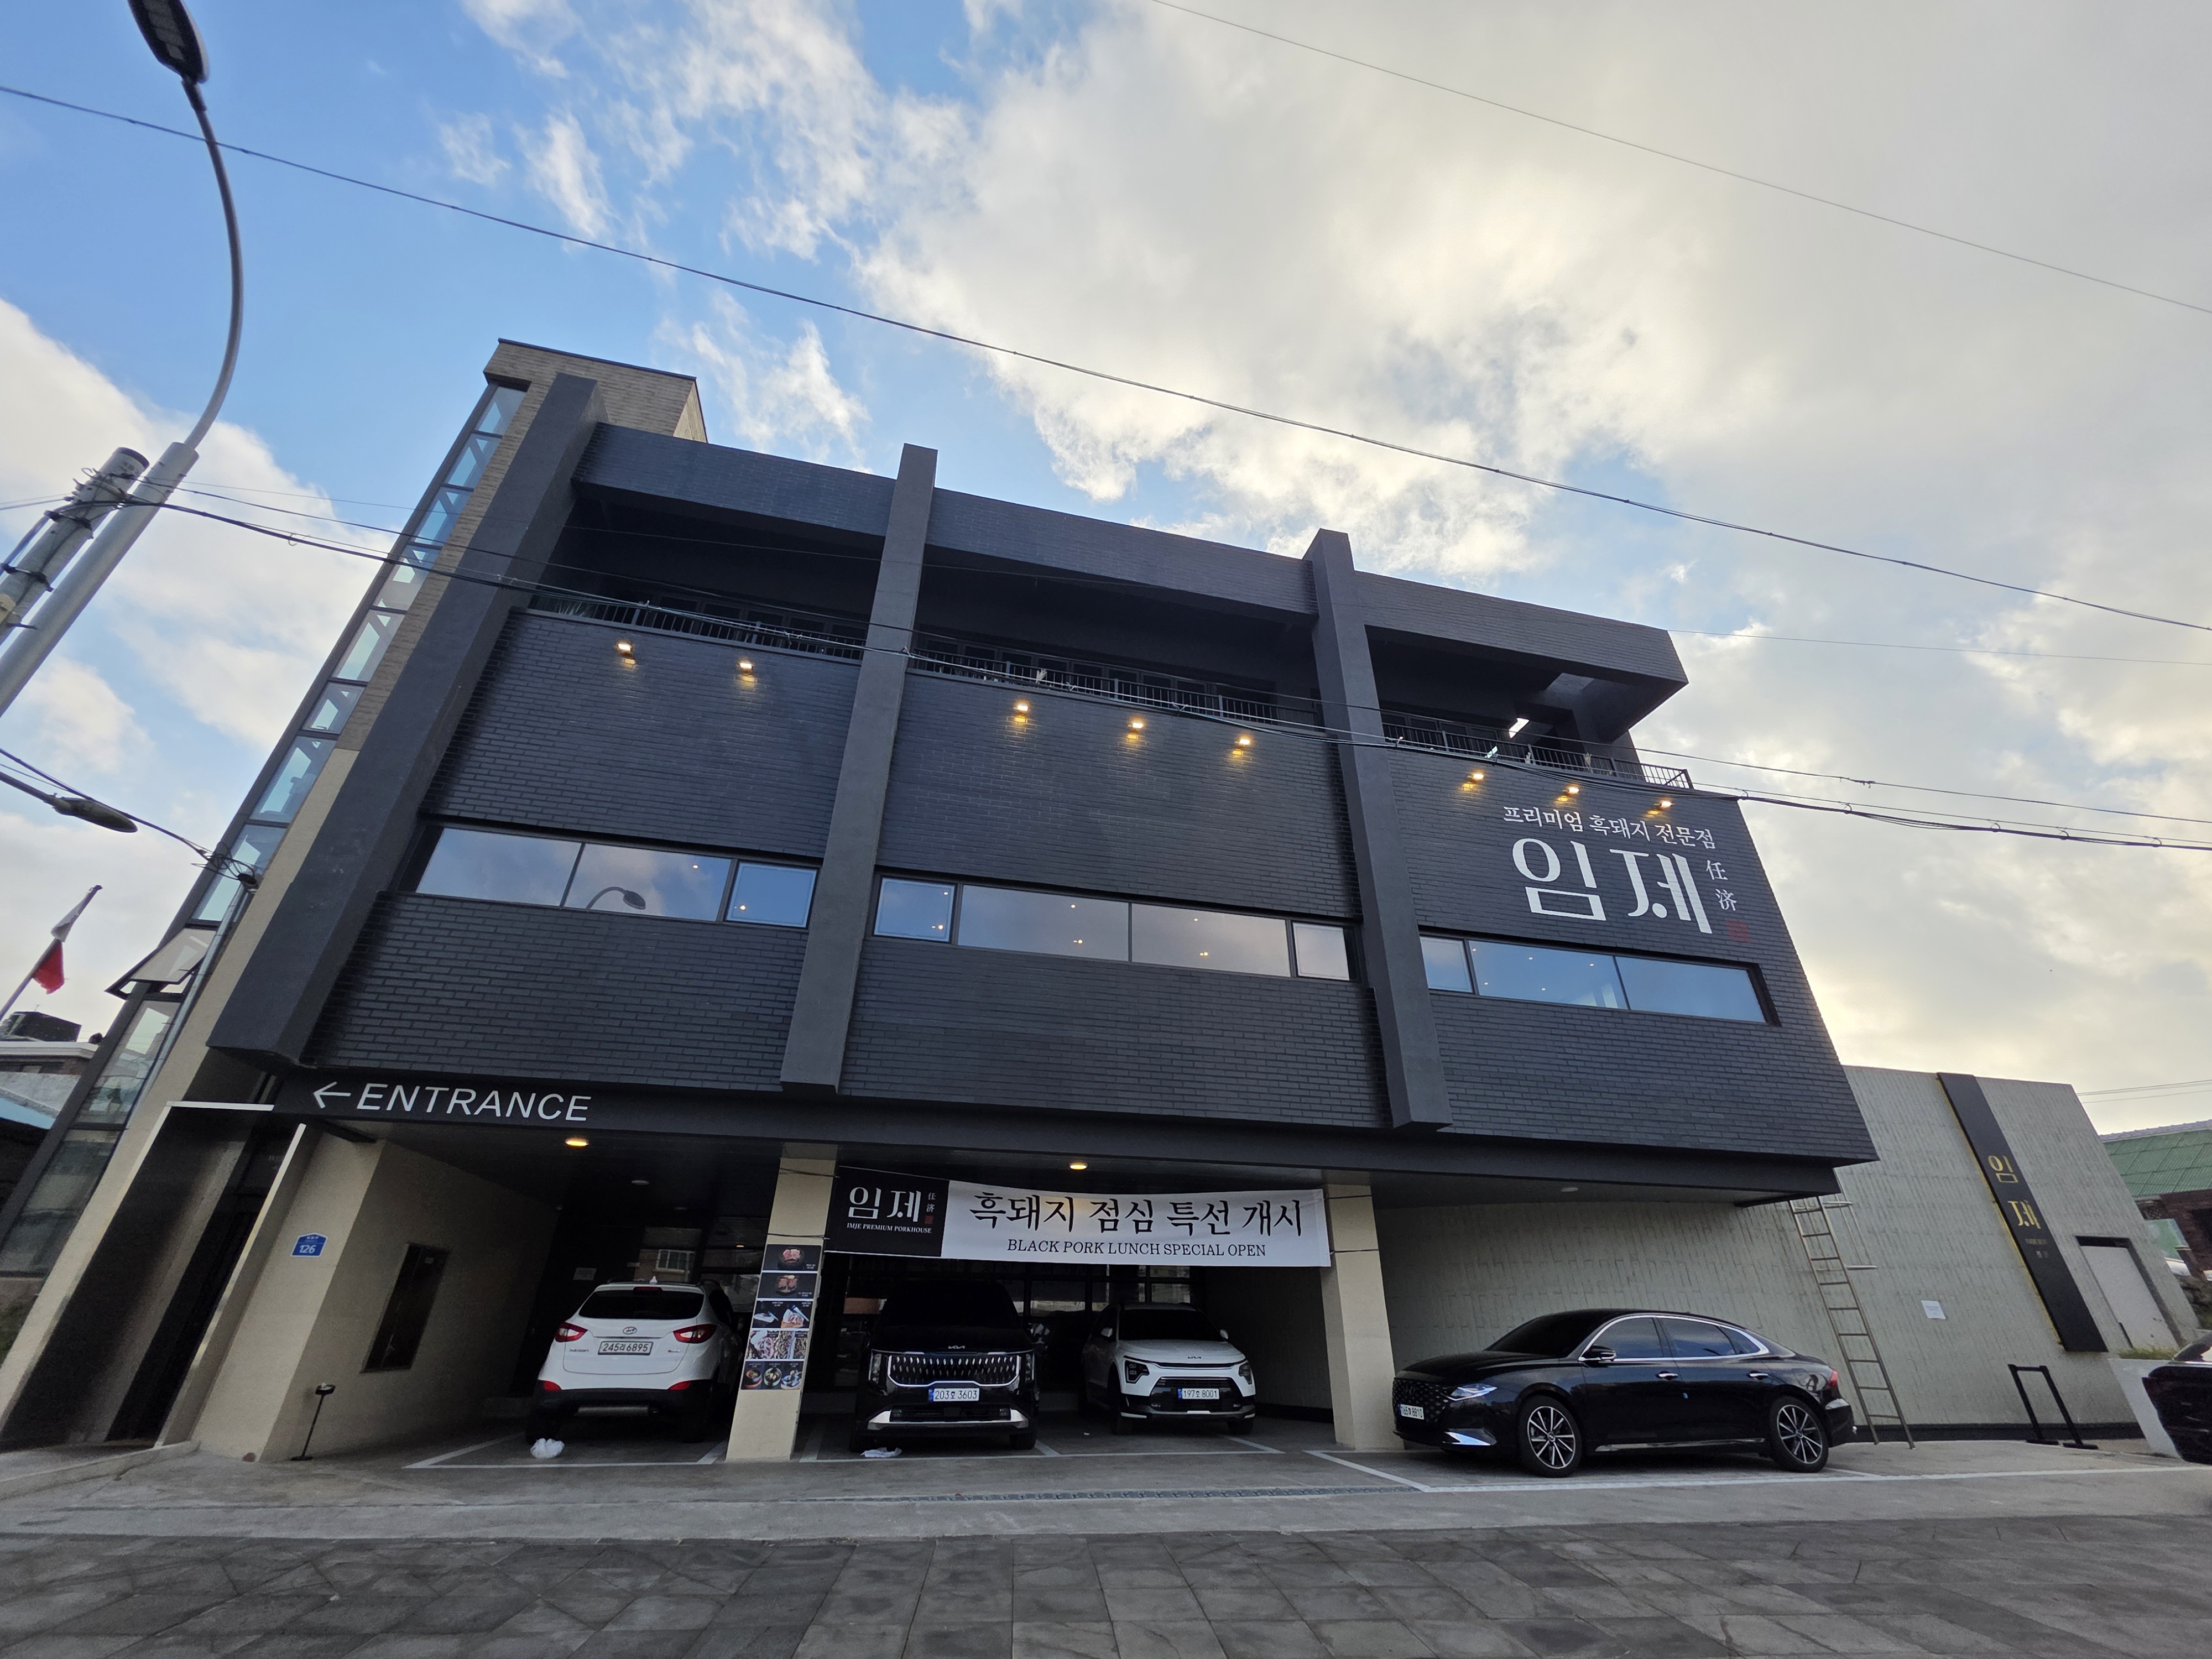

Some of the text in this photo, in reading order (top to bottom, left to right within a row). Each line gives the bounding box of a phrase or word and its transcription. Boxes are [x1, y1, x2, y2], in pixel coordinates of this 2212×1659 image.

[1503, 806, 1715, 849] 프리미엄 흑돼지 전문점
[357, 1083, 592, 1121] ENTRANCE
[848, 1187, 921, 1222] 임제
[969, 1191, 1302, 1237] 흑돼지 점심 특선 개시
[299, 1244, 317, 1254] 126
[1007, 1239, 1266, 1256] BLACK PORK LUNCH SPECIAL OPEN
